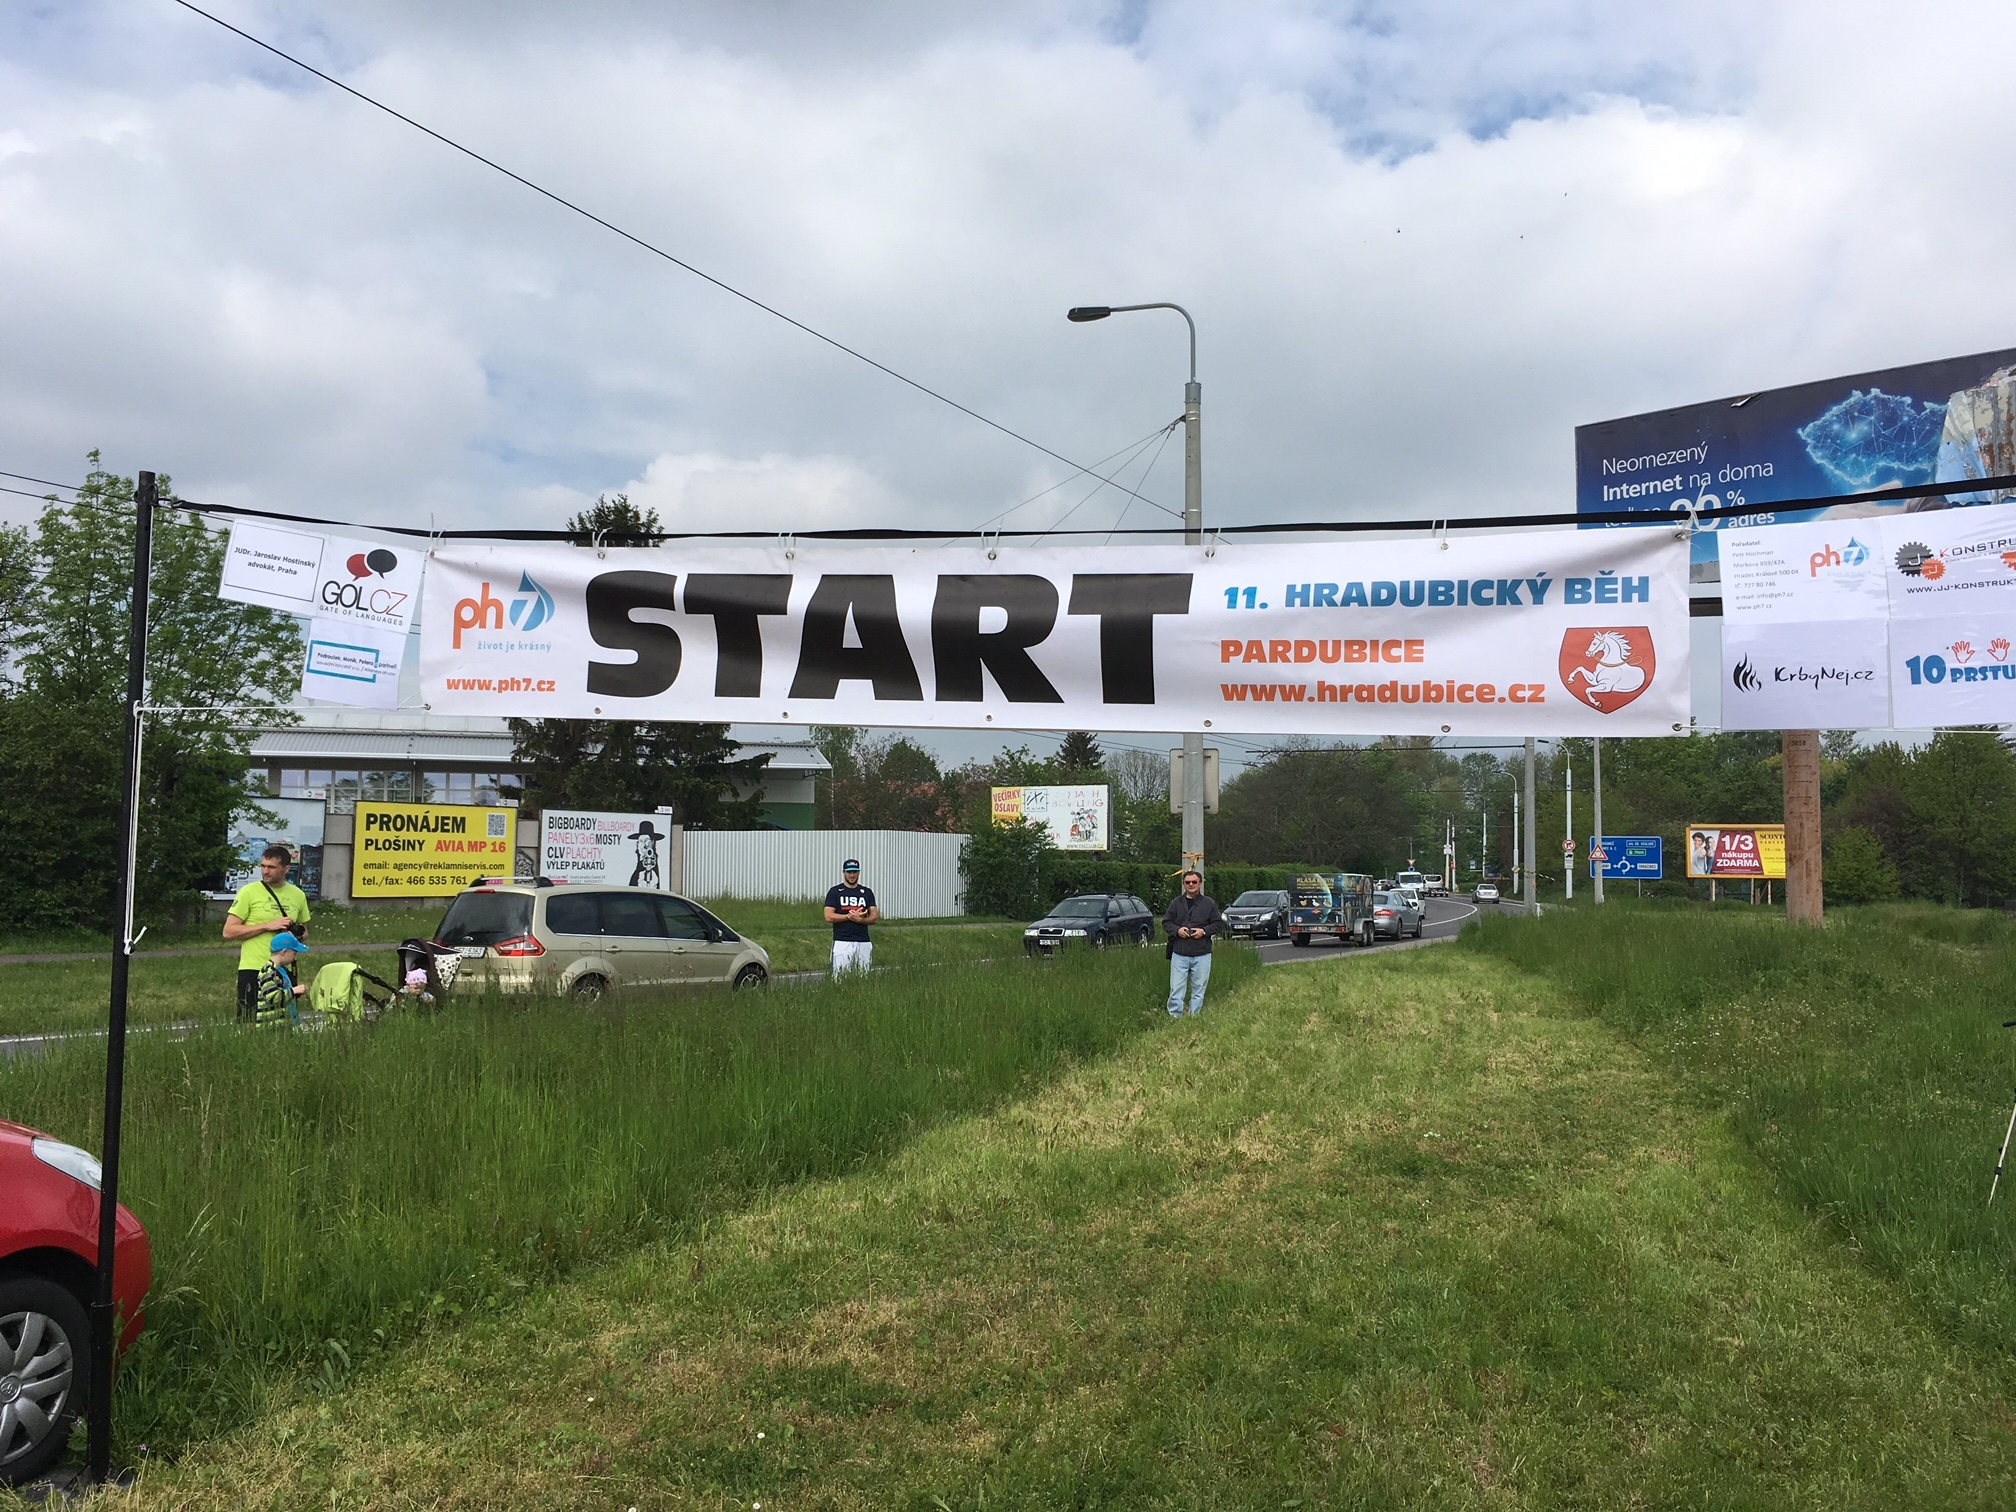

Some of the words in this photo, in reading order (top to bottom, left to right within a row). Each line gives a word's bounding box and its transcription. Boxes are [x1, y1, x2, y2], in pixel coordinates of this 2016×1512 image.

[1602, 440, 1708, 476] Neomezený
[1603, 474, 1683, 501] Internet
[1689, 472, 1711, 488] na
[1718, 462, 1774, 483] doma
[1728, 511, 1776, 528] adres
[234, 547, 252, 556] JUDr.
[253, 550, 281, 561] Jaroslav
[282, 556, 316, 568] Hostinský
[247, 561, 275, 572] advokát,
[277, 566, 297, 575] Praha
[1734, 571, 1754, 579] Hradec
[1223, 586, 1268, 610] 11.
[1284, 572, 1553, 608] HRADUBICKÝ
[1563, 570, 1650, 605] BĚH
[1757, 592, 1793, 600] info@ph7.cz
[319, 605, 339, 614] GATE
[356, 611, 404, 626] LANGUAGES
[585, 569, 1194, 705] START
[477, 641, 503, 650] život
[505, 641, 515, 653] je
[518, 640, 552, 653] krásný
[1220, 639, 1425, 664] PARDUBICE
[1774, 666, 1875, 690] KrbyNej.cz
[1905, 655, 1947, 685] 10
[446, 677, 556, 694] www.ph7.cz
[1220, 680, 1546, 703] www.hradubice.cz
[994, 803, 1020, 813] OSLAVY
[365, 810, 466, 833] PRONÁJEM
[548, 816, 597, 831] BIGBOARDY
[597, 820, 636, 832] BILLBOARDY
[364, 835, 425, 851] PLOŠINY
[435, 839, 465, 853] AVIA
[468, 841, 487, 853] MP
[490, 841, 506, 853] 16
[595, 833, 622, 846] MOSTY
[1721, 834, 1754, 851] 1/3
[547, 846, 565, 859] CLV
[565, 847, 603, 860] PLACHTY
[1721, 851, 1754, 859] nákupu
[363, 861, 390, 870] email:
[392, 861, 505, 871] agency@reklamniservis.com
[546, 859, 570, 870] VÝLEP
[571, 859, 605, 870] PLAKÁTŮ
[1716, 858, 1760, 867] ZDARMA
[362, 876, 403, 887] tel./fax:
[406, 876, 425, 885] 466
[428, 876, 447, 885] 535
[450, 876, 467, 885] 761
[840, 896, 866, 907] USA
